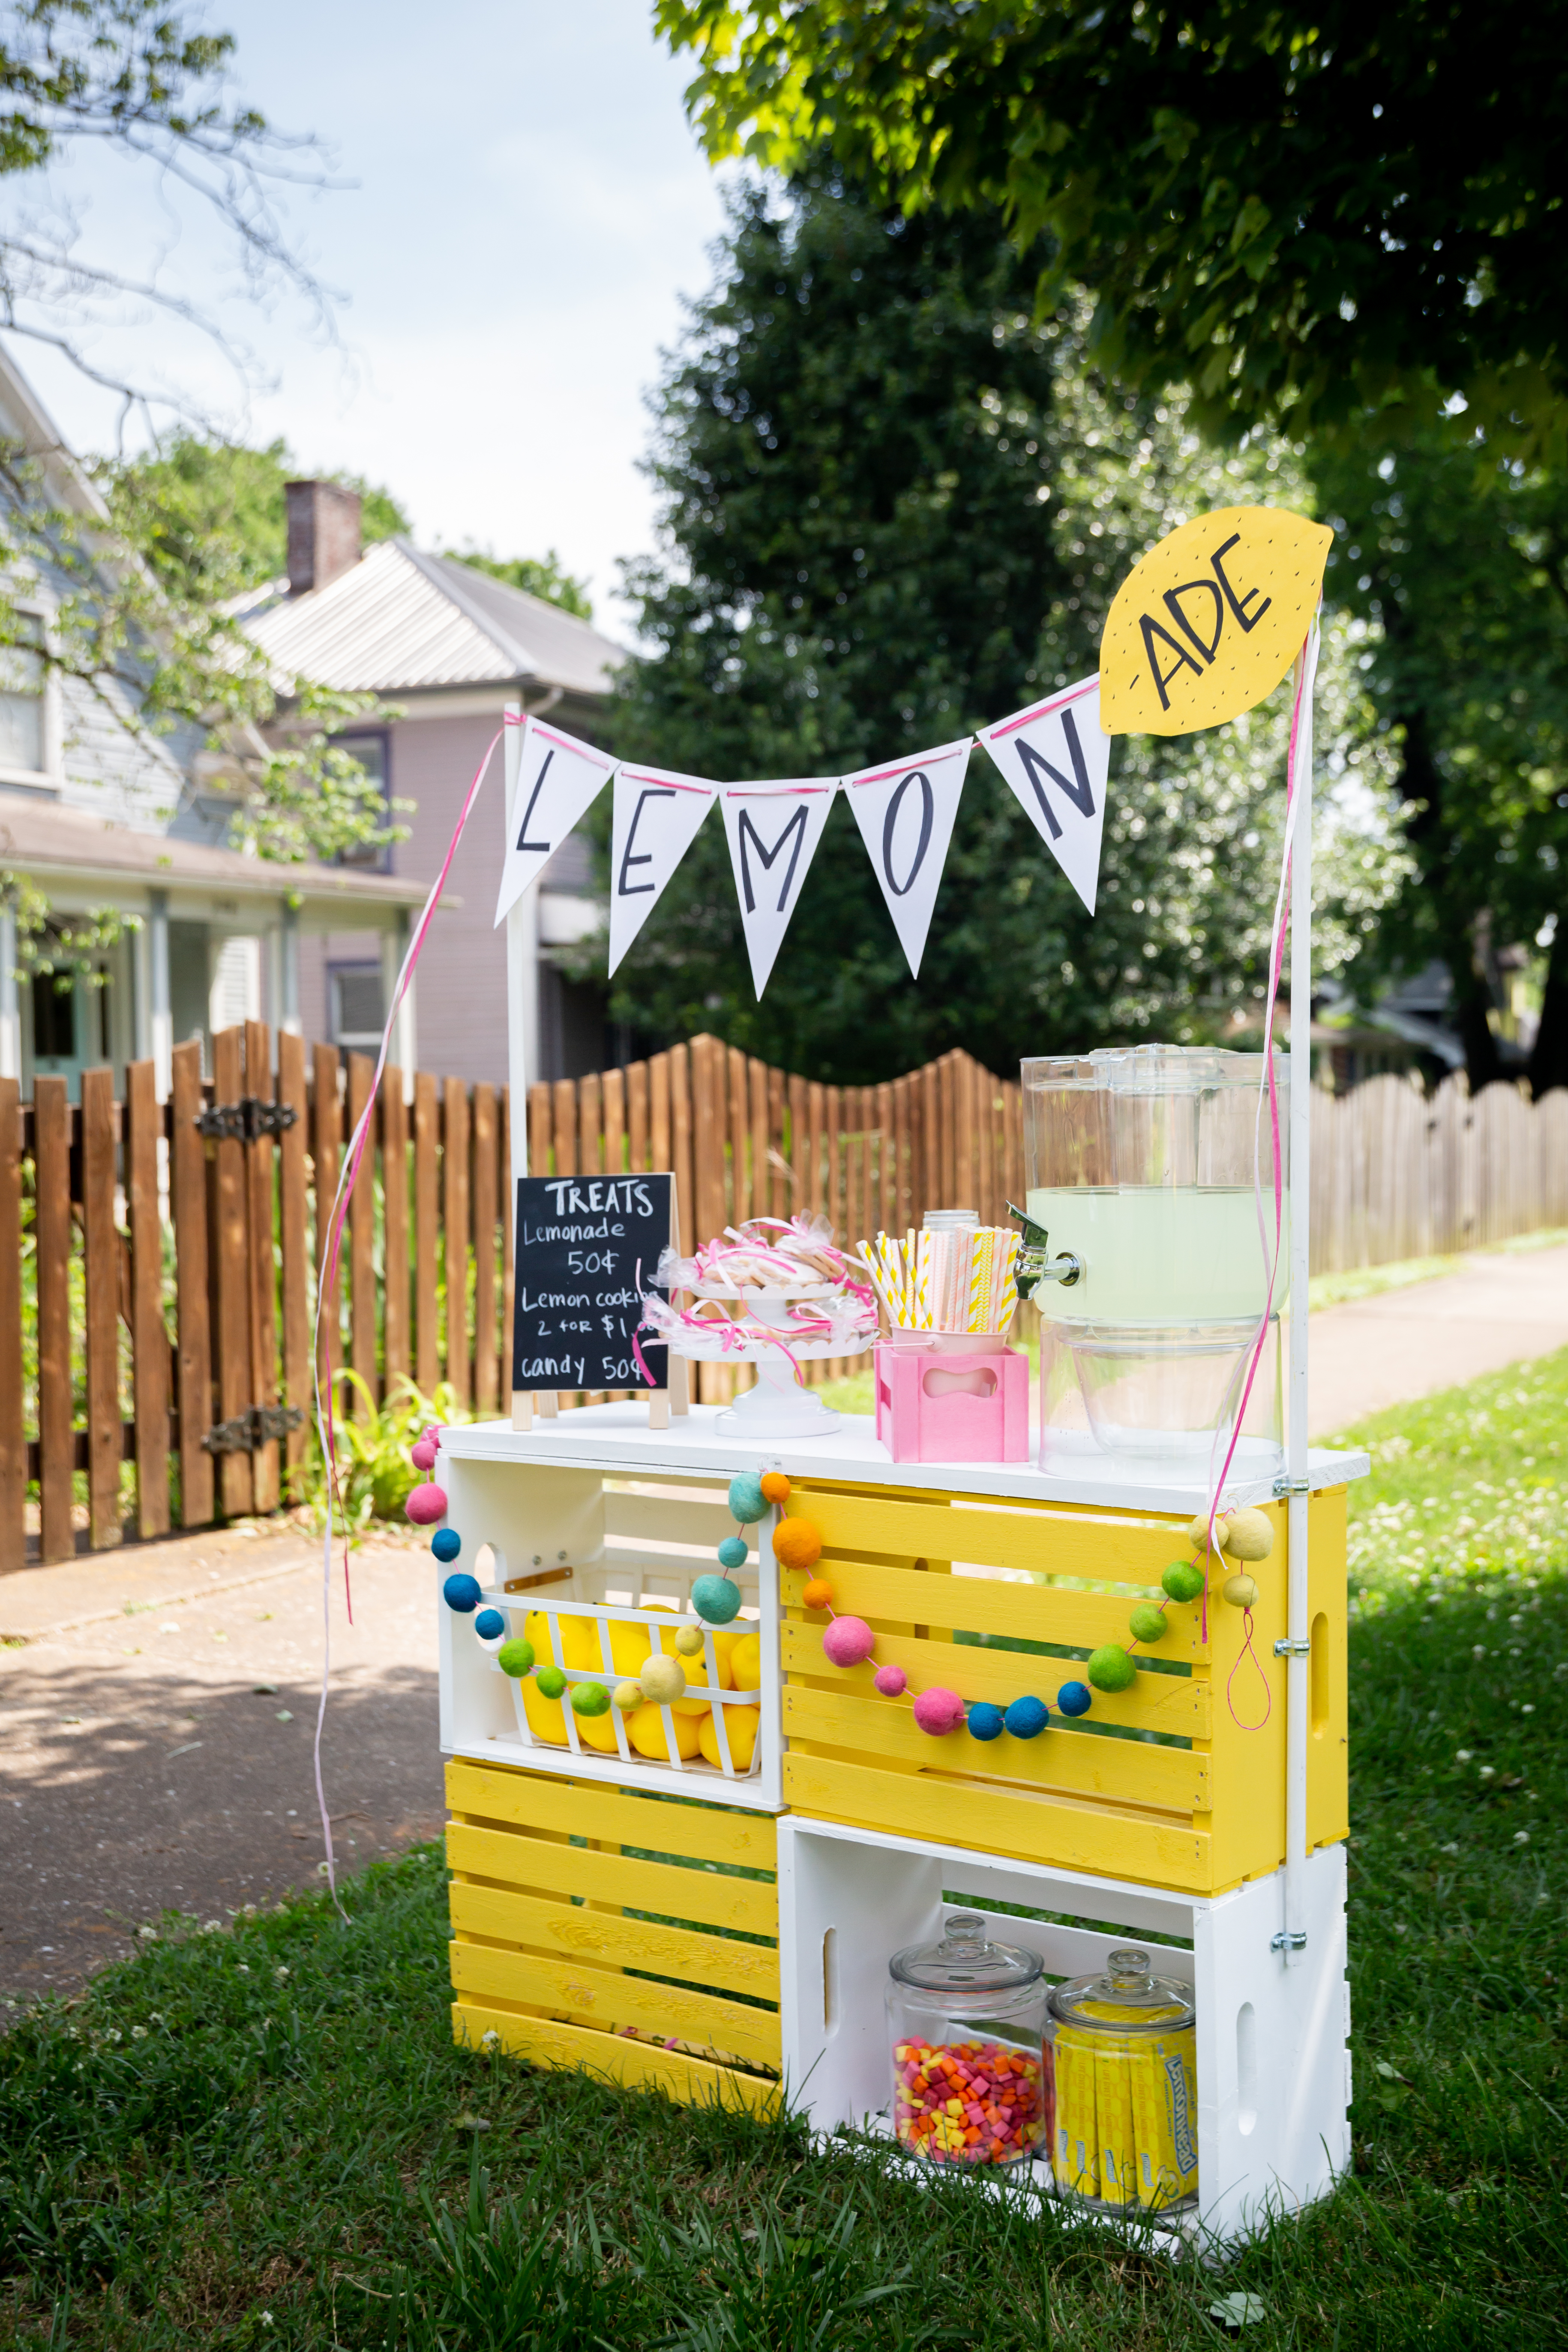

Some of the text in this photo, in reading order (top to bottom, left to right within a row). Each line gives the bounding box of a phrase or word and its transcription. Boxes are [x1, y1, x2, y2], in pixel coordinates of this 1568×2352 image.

[516, 708, 1096, 914] LEMON
[544, 1179, 654, 1217] TREATS
[524, 1217, 626, 1245] Lemonade
[568, 1249, 620, 1275] 50¢
[522, 1286, 590, 1312] Lemon
[538, 1320, 552, 1336] 2
[522, 1354, 585, 1385] candy
